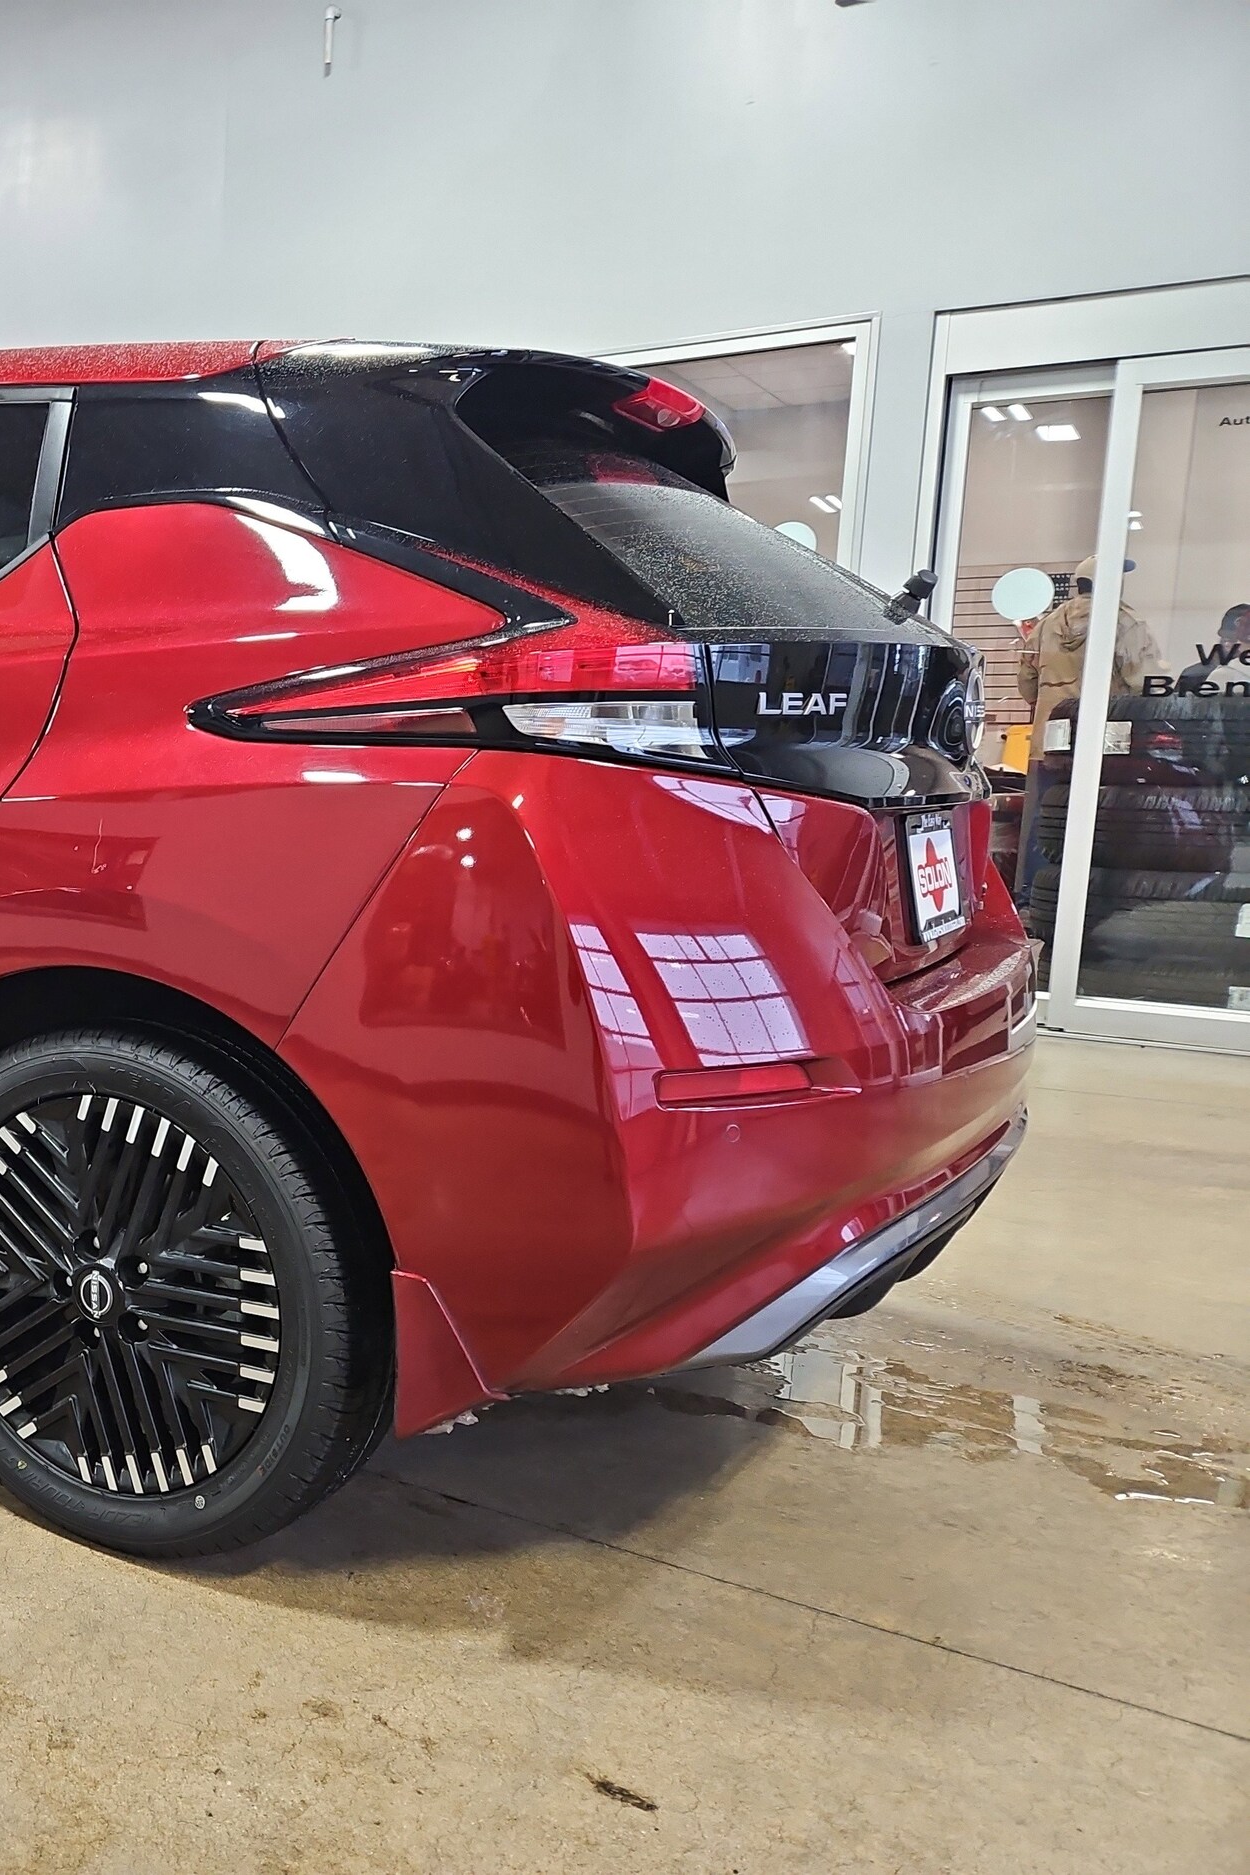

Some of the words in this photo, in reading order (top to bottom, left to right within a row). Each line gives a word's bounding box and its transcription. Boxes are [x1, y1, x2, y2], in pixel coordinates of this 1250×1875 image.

[1195, 643, 1250, 667] We
[756, 691, 848, 716] LEAF
[917, 857, 953, 897] SOLON
[91, 1269, 101, 1319] NISSAN
